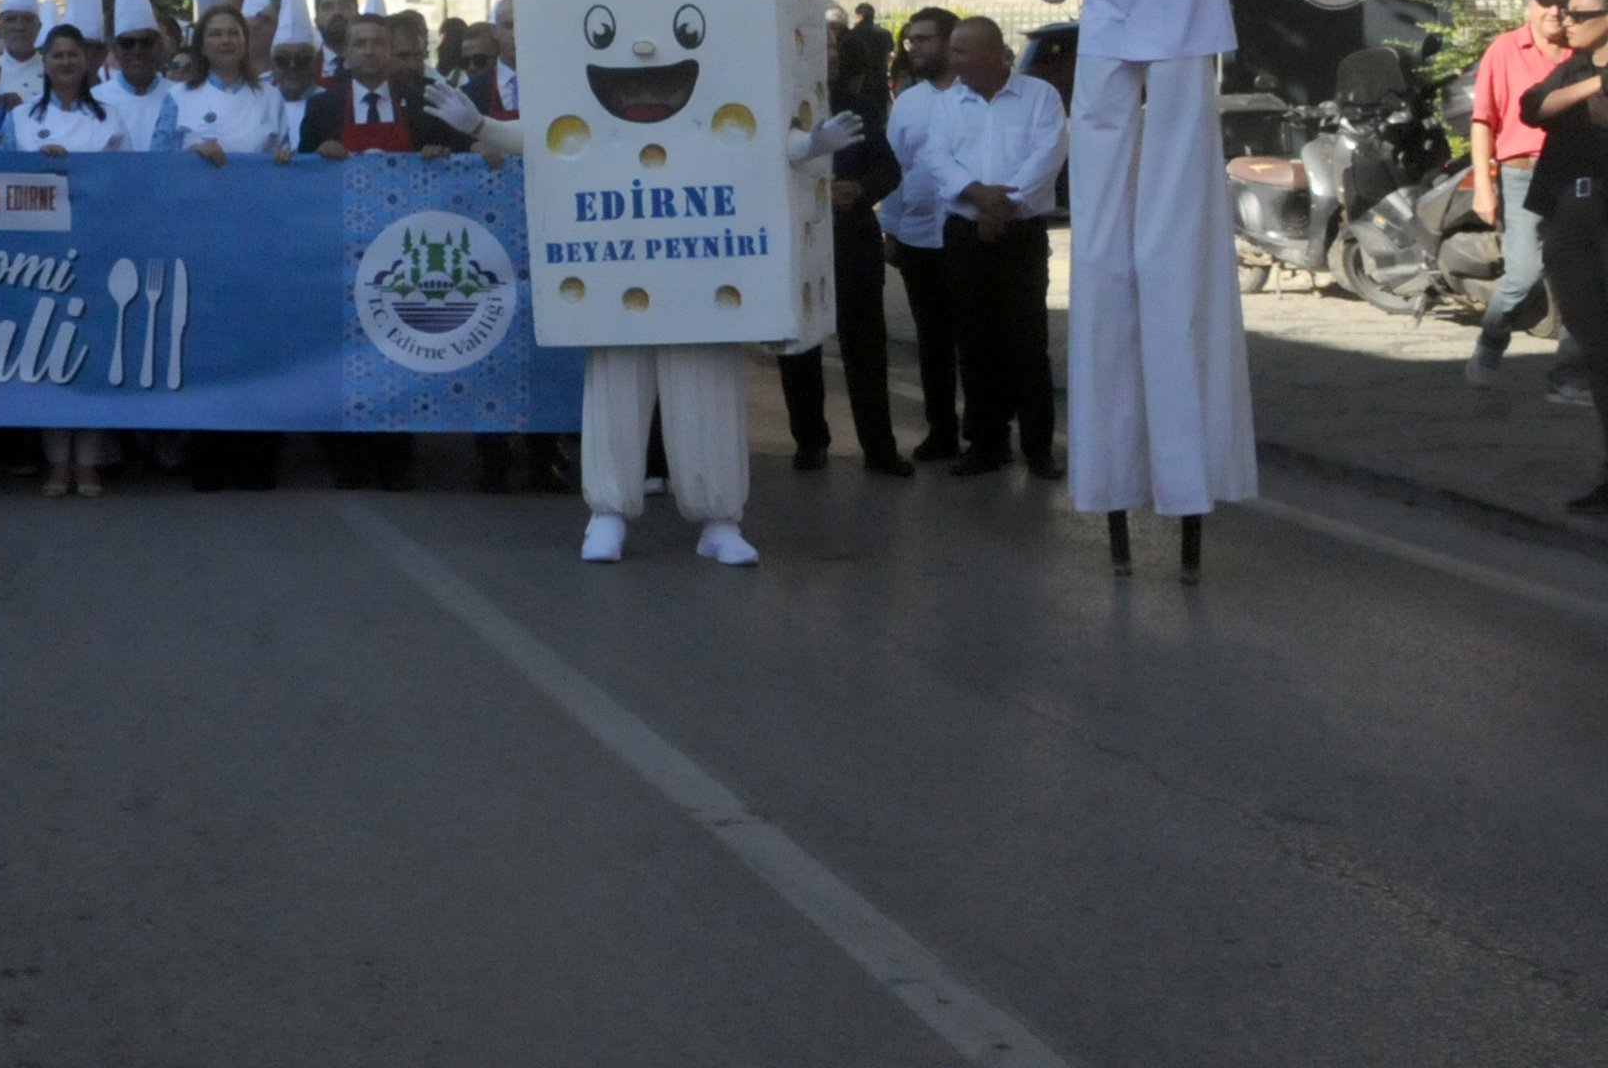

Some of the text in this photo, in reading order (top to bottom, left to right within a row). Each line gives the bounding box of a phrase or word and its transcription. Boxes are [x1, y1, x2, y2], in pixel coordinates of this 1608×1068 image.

[575, 179, 737, 222] EDİRNE
[546, 227, 768, 264] BEYAZ PEYNİRİ
[386, 327, 447, 360] Edirne
